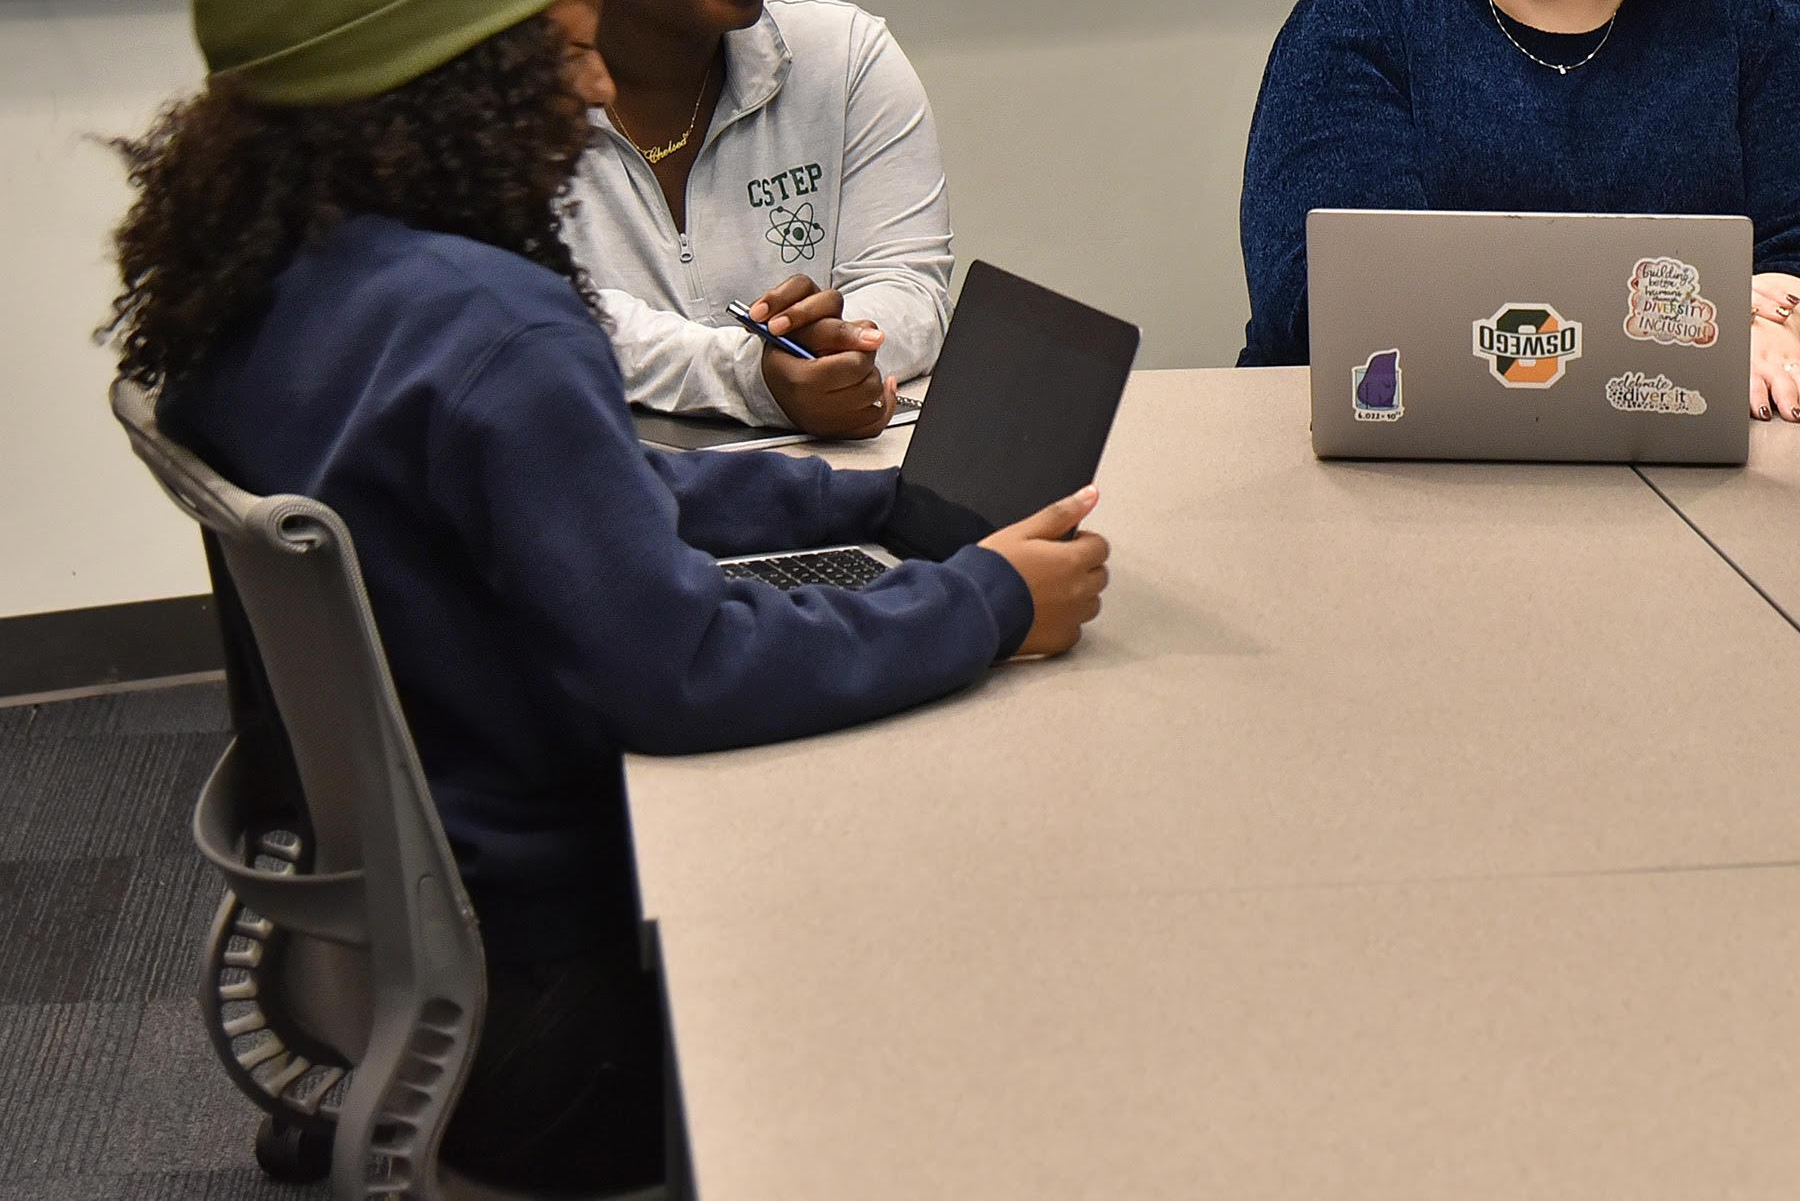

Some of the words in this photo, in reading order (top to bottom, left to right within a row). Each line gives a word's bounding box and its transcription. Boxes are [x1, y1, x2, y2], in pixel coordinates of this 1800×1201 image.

[747, 162, 823, 209] CSTEP
[1642, 264, 1689, 285] building
[1644, 301, 1706, 318] DIVERSITY
[1658, 313, 1681, 323] and
[1639, 316, 1707, 337] INCLUSION
[1480, 325, 1576, 356] OSWEGO
[1611, 375, 1672, 390] celebrate
[1623, 388, 1697, 404] diversity
